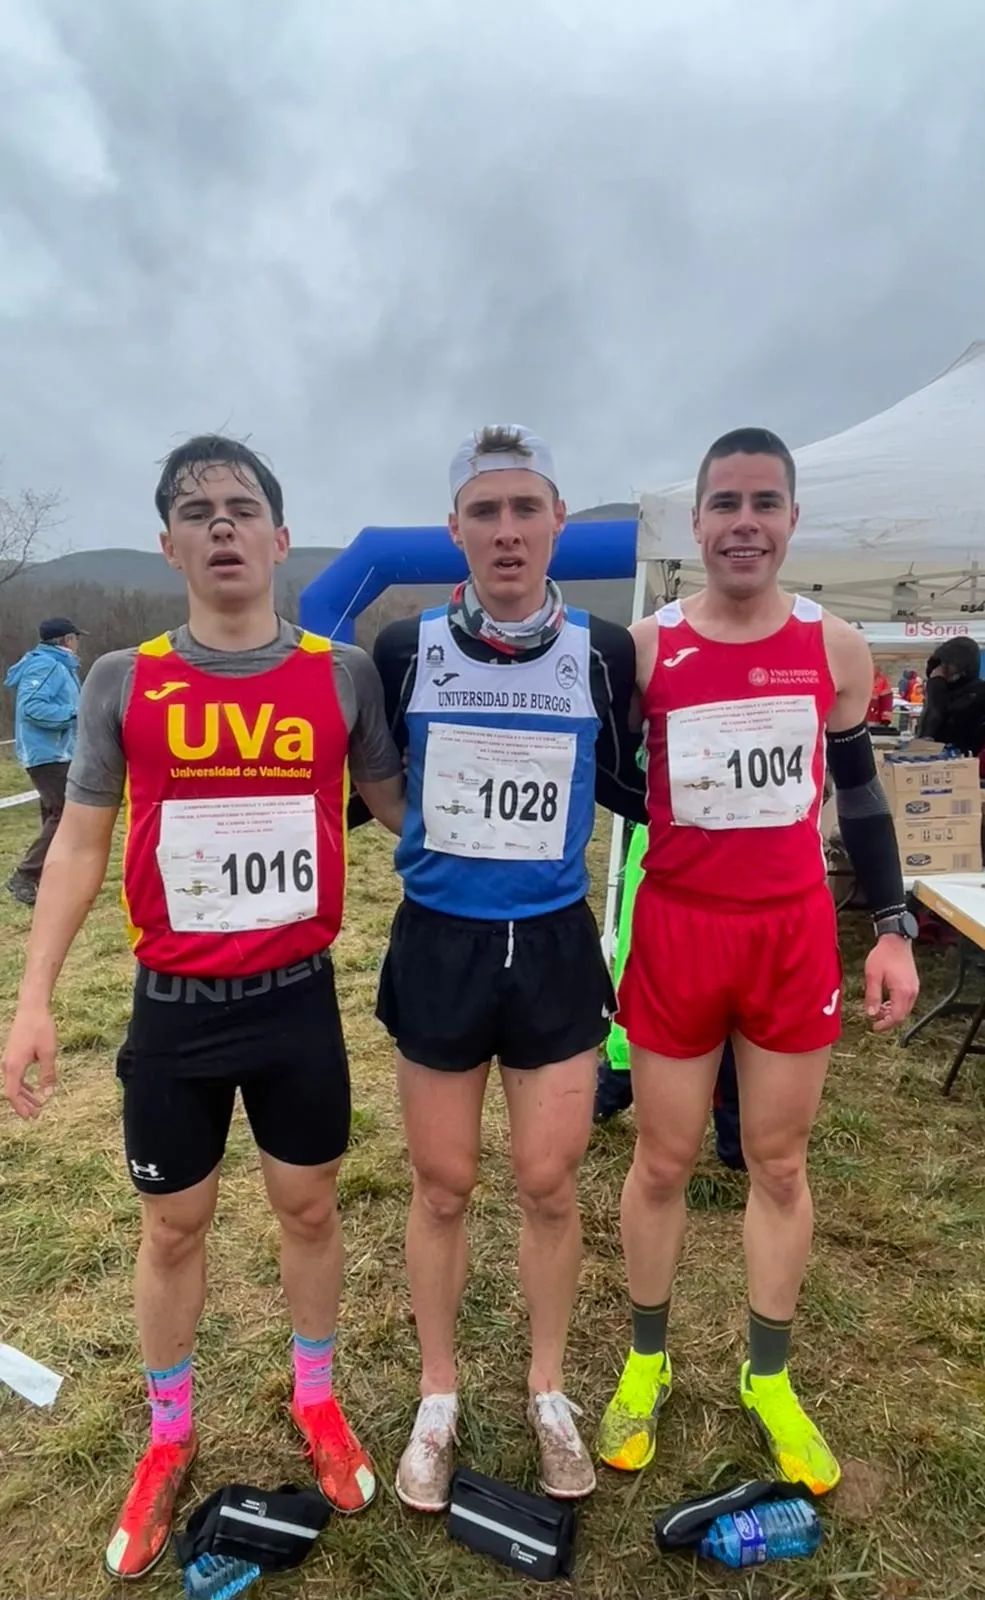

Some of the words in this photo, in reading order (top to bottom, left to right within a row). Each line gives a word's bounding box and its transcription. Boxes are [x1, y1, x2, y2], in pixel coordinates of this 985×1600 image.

[921, 621, 969, 637] Soria
[438, 691, 509, 707] UNIVERSIDAD
[512, 692, 528, 708] DE
[530, 693, 571, 713] BURGOS
[167, 703, 314, 761] UVa
[170, 766, 241, 778] Universidad
[243, 767, 257, 777] de
[259, 766, 313, 779] Valladolid
[727, 745, 804, 789] 1004
[478, 778, 559, 822] 1028
[221, 848, 314, 896] 1016
